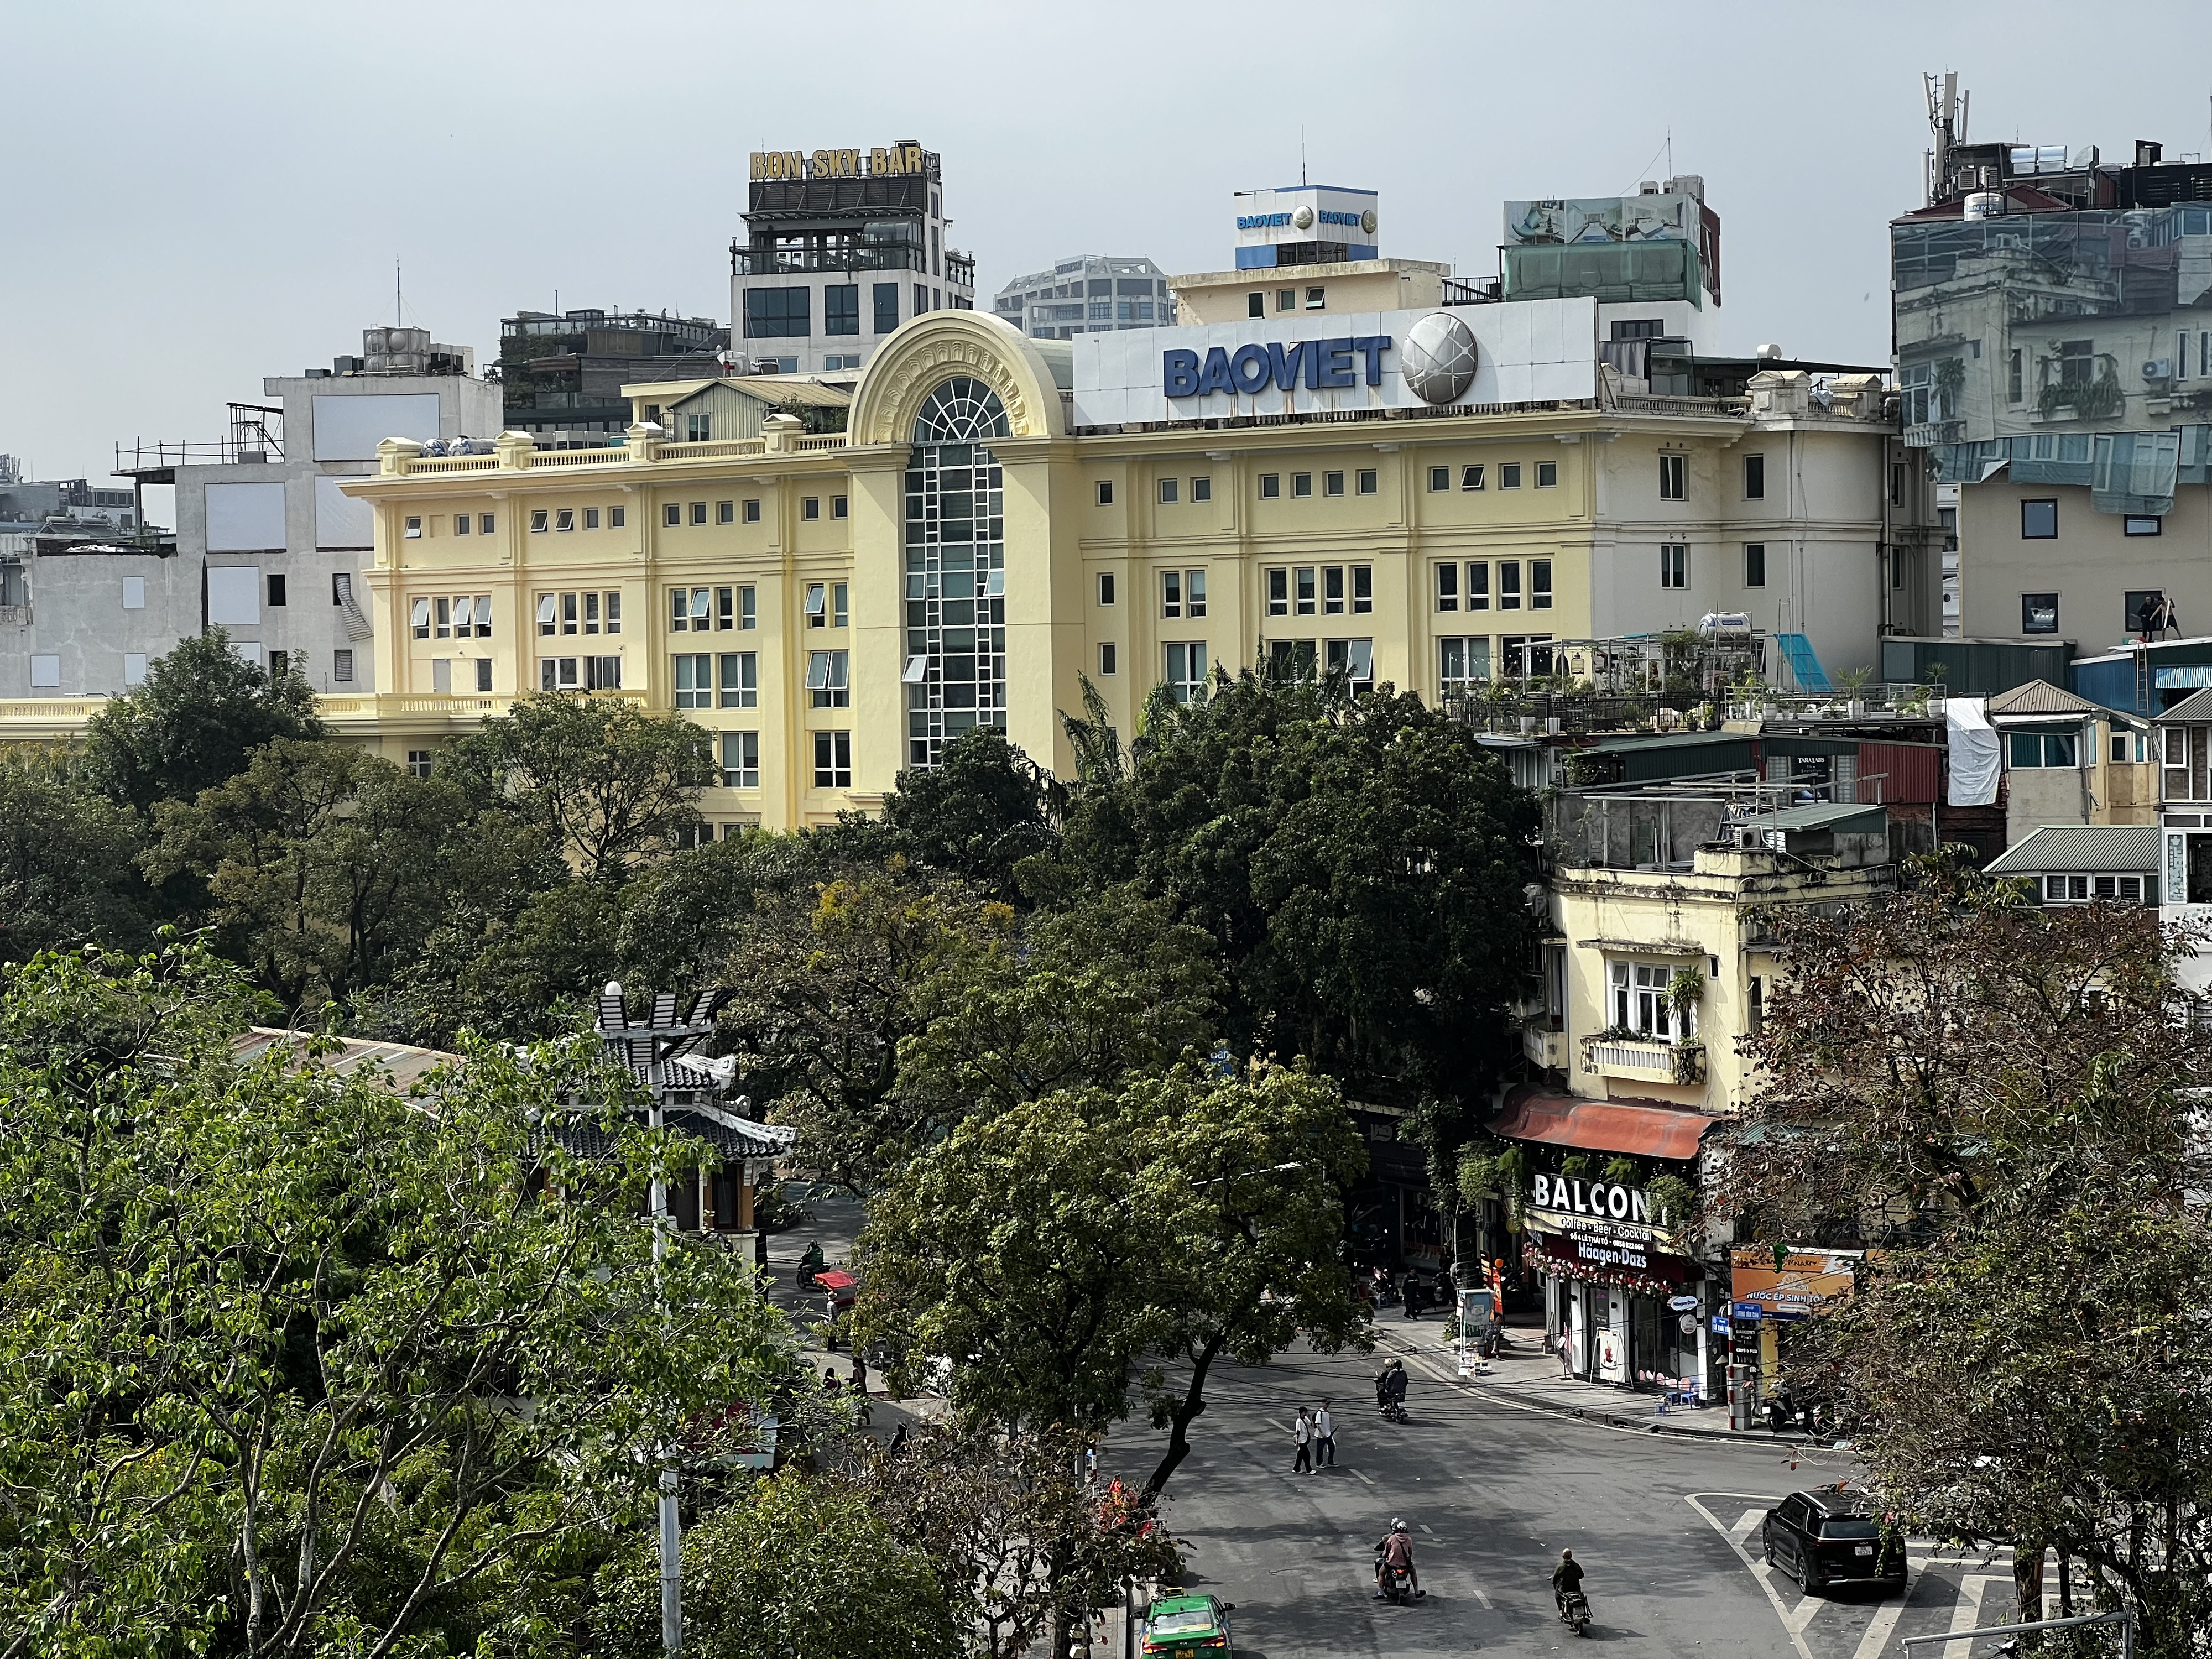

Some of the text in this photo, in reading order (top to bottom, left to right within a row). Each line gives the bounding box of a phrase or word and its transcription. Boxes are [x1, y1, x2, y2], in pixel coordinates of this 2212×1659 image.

[750, 147, 922, 180] BON SKY BAR
[1237, 213, 1292, 229] BAOVIET
[1319, 210, 1361, 226] BAOVIET
[1164, 335, 1391, 398] BAOVIET
[1535, 1175, 1667, 1226] BALCON
[1561, 1217, 1587, 1231] Coffee
[1593, 1222, 1611, 1235] Beer
[1618, 1225, 1652, 1241] Cocktail
[1773, 1292, 1785, 1301] ÉP
[1786, 1294, 1807, 1302] SINH
